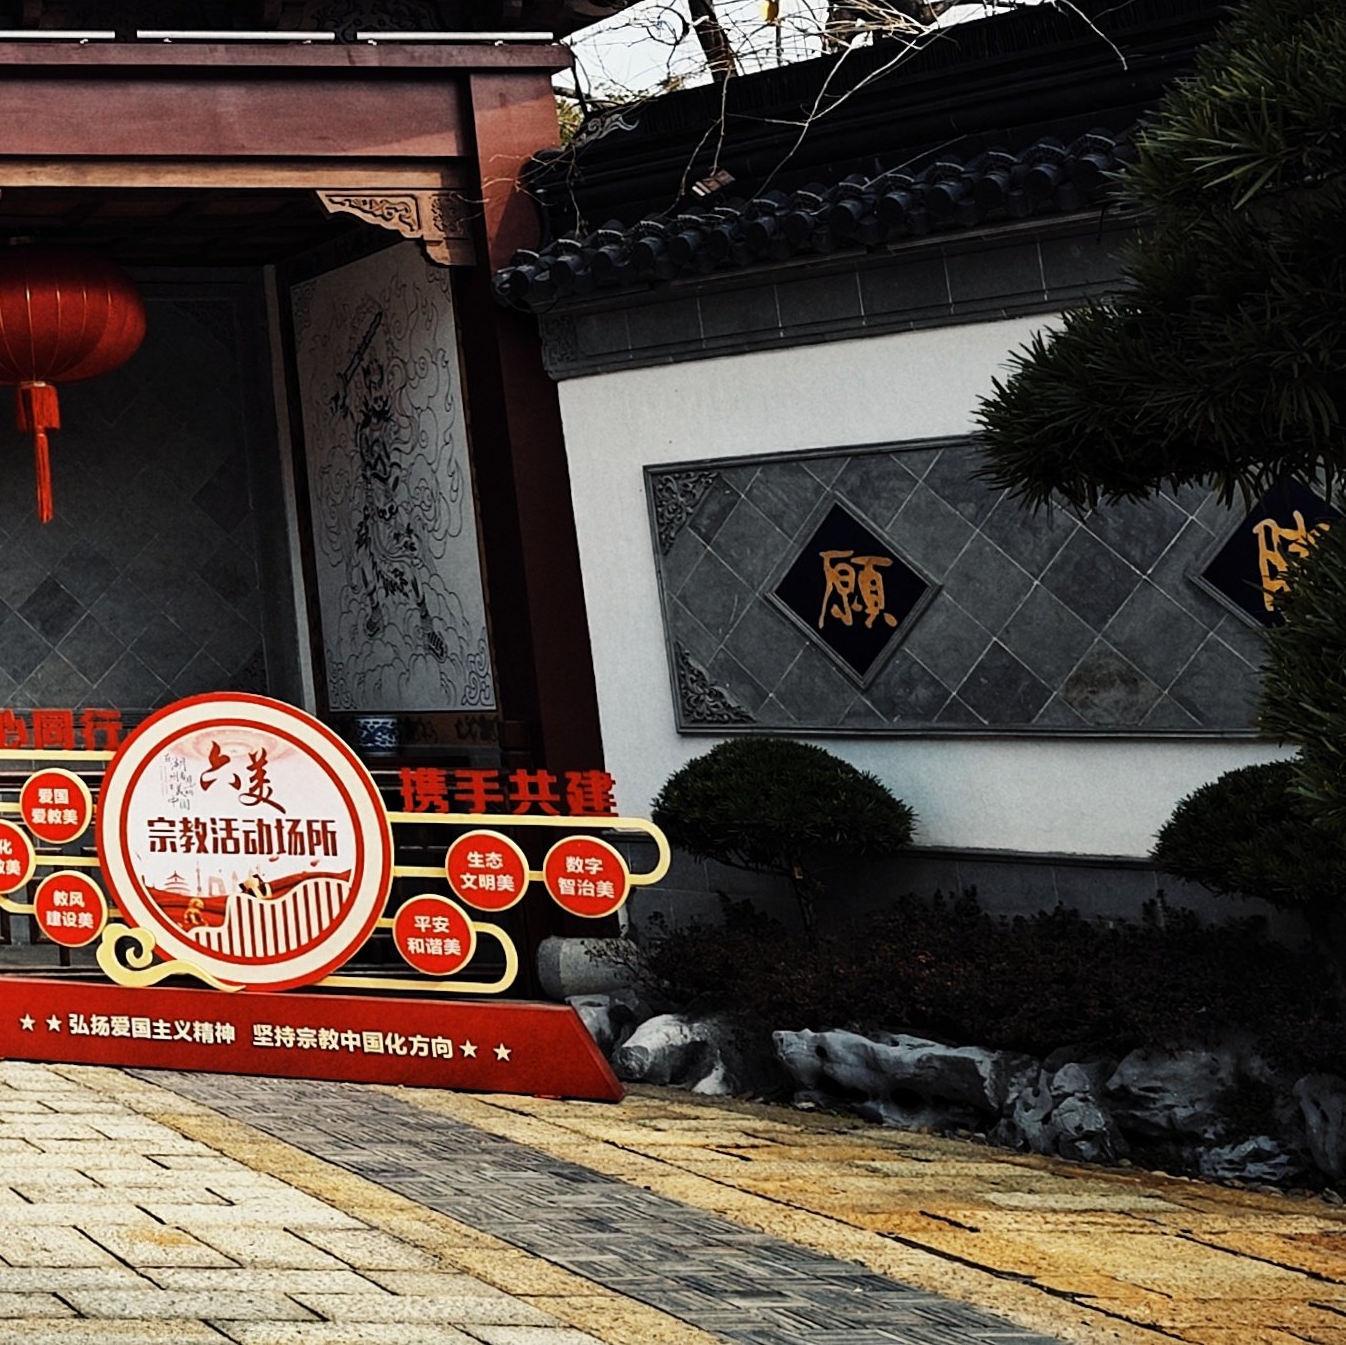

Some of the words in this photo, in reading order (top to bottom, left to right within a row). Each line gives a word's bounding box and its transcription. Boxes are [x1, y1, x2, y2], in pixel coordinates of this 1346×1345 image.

[818, 549, 898, 630] 願
[199, 740, 287, 815] 六美
[37, 787, 70, 805] 爱国
[398, 766, 619, 818] 携手共建
[30, 807, 79, 826] 爱教美
[147, 816, 339, 857] 宗教活动场所
[466, 850, 504, 870] 生态
[564, 855, 604, 876] 数字
[459, 871, 516, 893] 文明美
[557, 877, 615, 899] 智治美
[52, 889, 86, 908] 教风
[45, 910, 94, 929] 建设美
[413, 915, 451, 934] 平安
[406, 936, 462, 957] 和谐美
[67, 1013, 236, 1045] 弘扬爱国主义精神
[251, 1023, 454, 1059] 坚持宗教中国化方向
